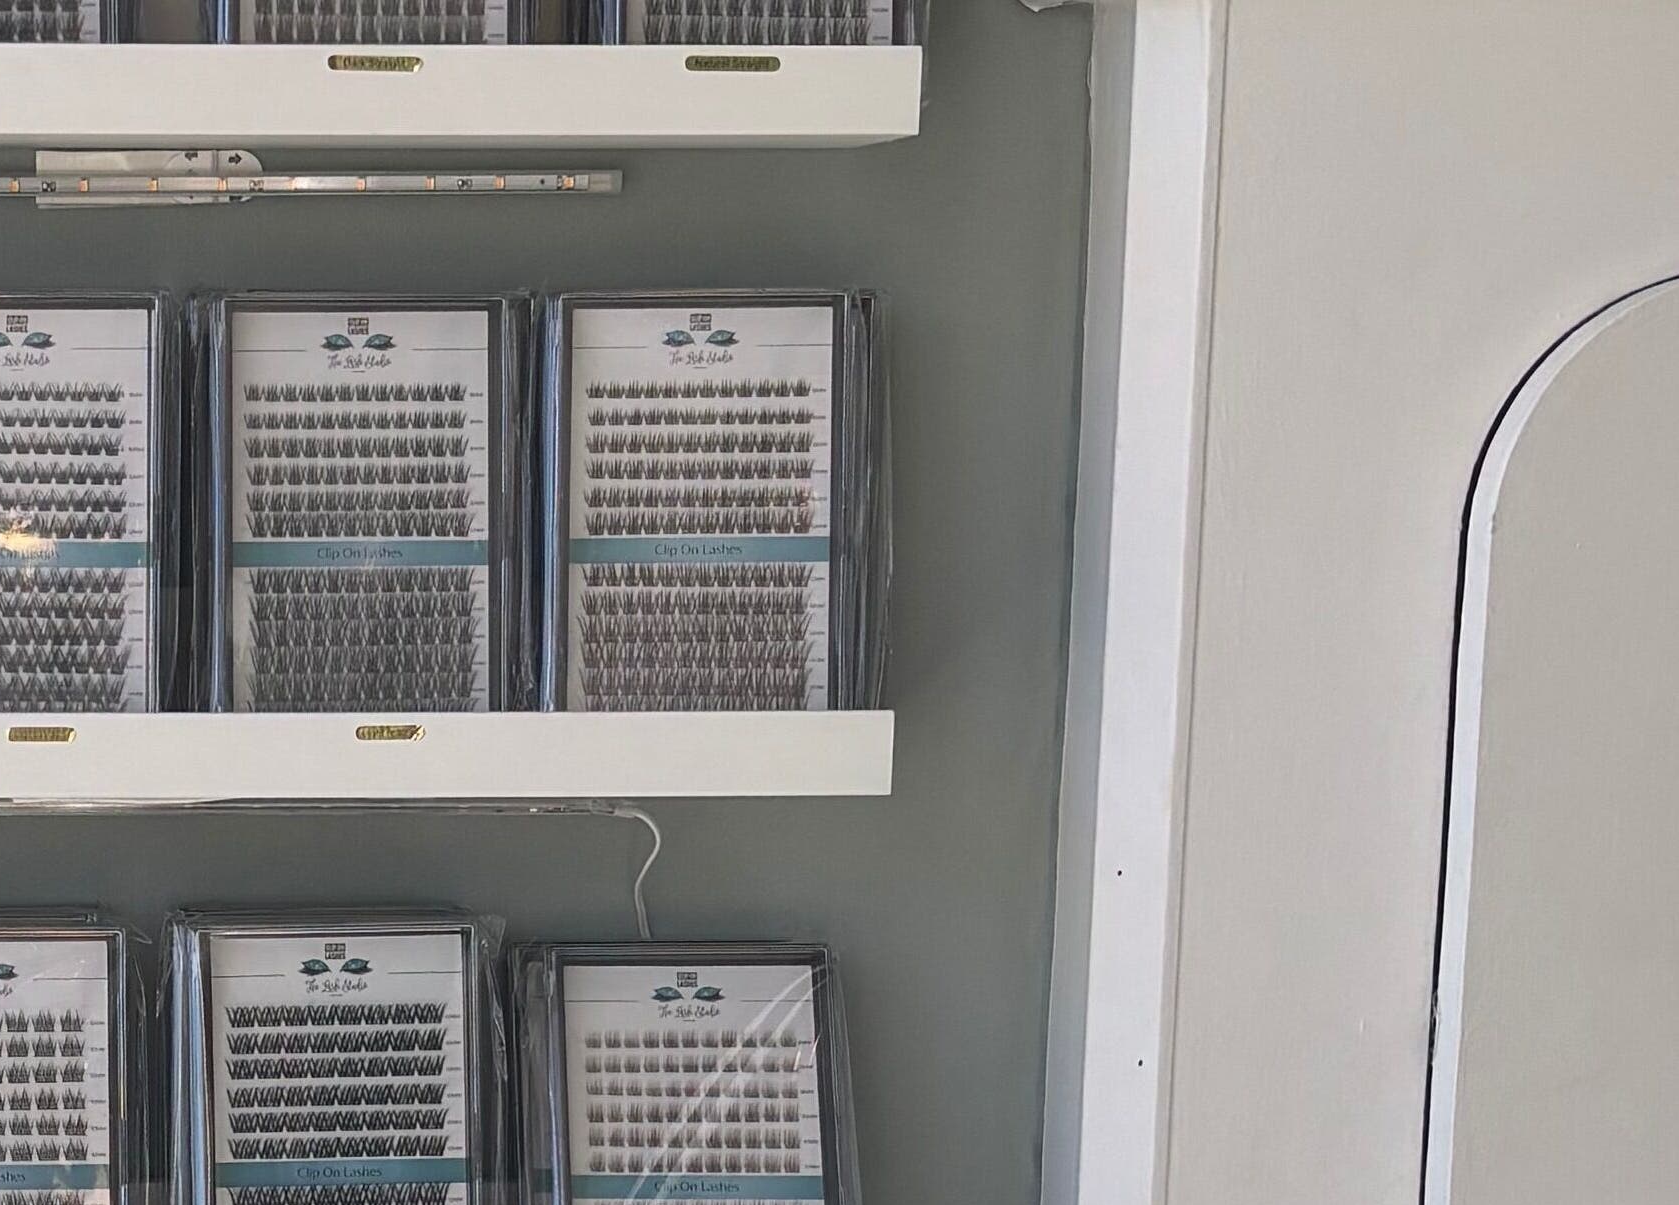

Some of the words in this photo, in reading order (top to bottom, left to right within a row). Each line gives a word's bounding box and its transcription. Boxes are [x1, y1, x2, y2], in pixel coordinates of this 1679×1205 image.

[317, 547, 340, 561] Clip
[342, 547, 361, 559] On
[364, 546, 403, 559] Lashes
[655, 544, 678, 558] Clip
[681, 544, 699, 556] On
[702, 543, 742, 556] Lashes
[297, 1166, 320, 1181] Clip
[323, 1166, 341, 1179] On
[343, 1165, 383, 1179] Lashes
[680, 1181, 698, 1193] On
[701, 1180, 740, 1193] Lashes
